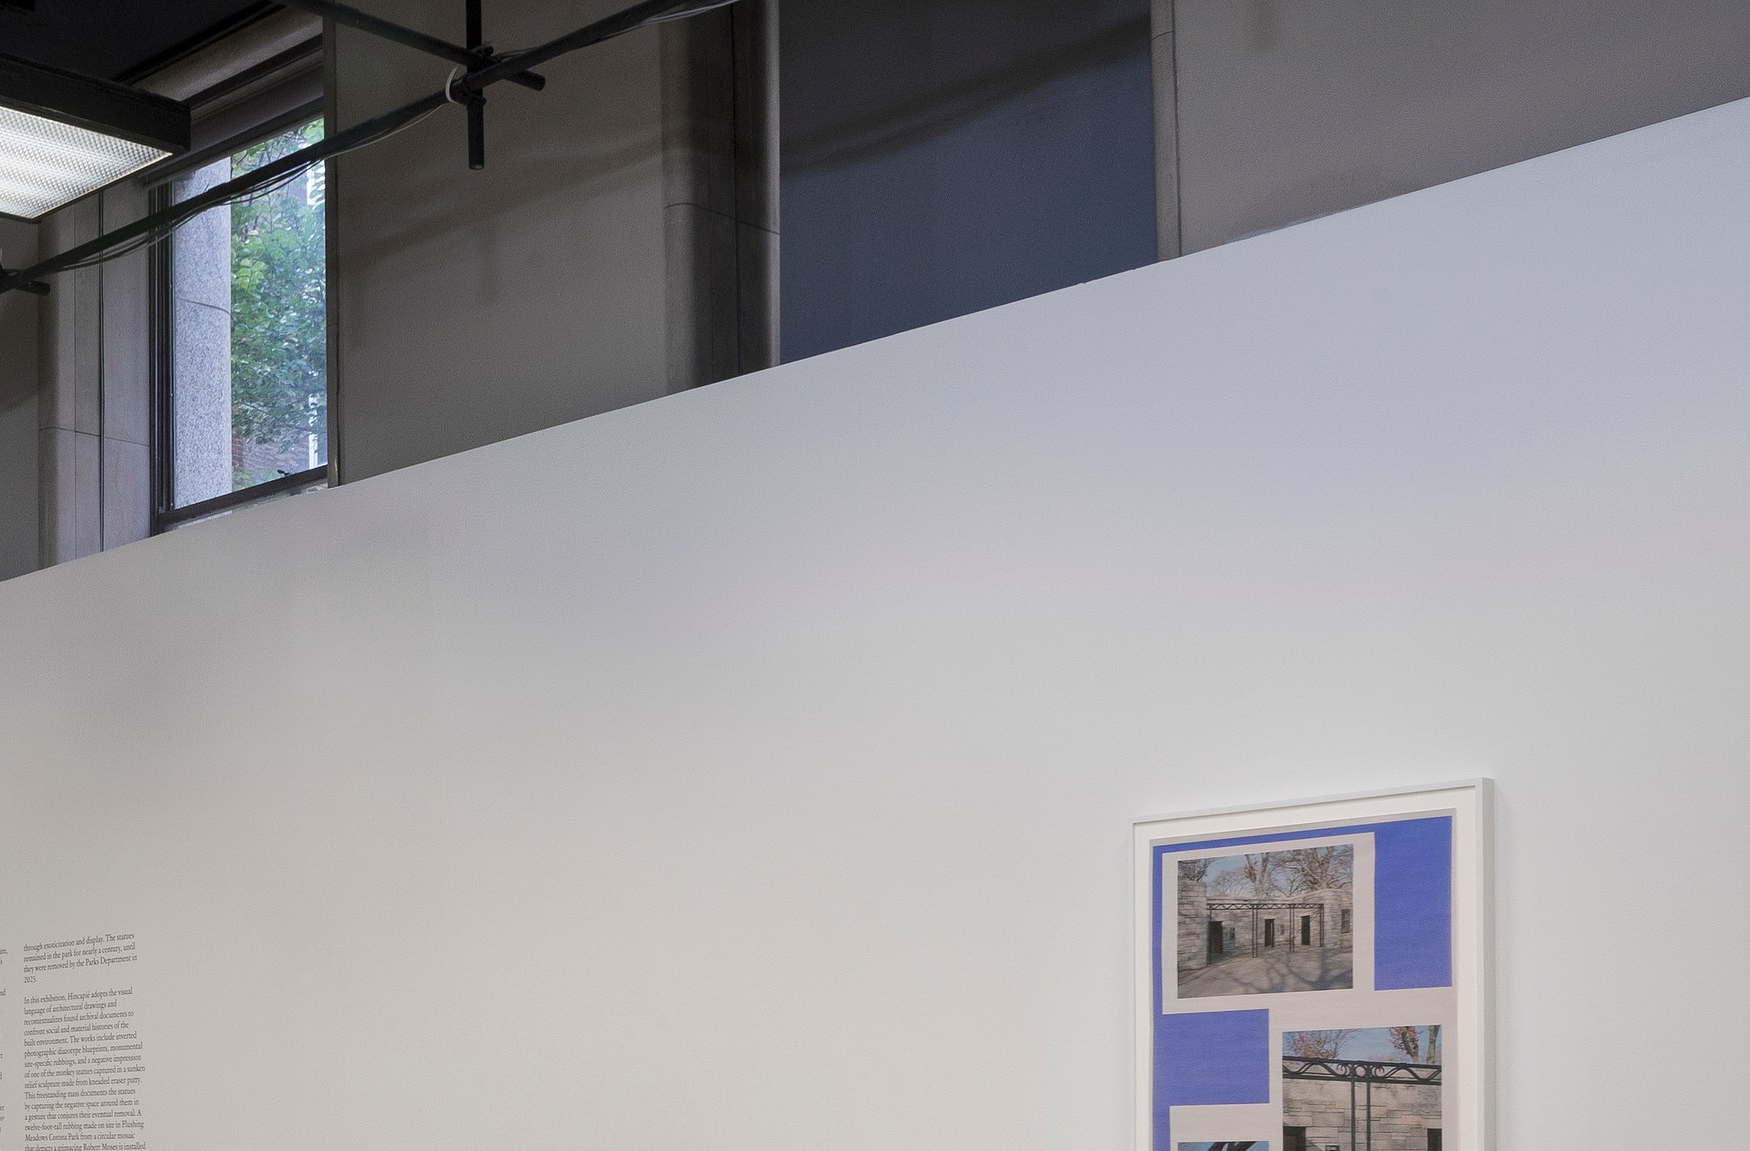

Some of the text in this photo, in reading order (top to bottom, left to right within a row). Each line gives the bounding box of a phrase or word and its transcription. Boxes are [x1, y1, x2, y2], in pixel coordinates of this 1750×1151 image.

[24, 942, 43, 952] through
[76, 937, 85, 946] and
[106, 934, 116, 942] The
[117, 933, 134, 941] statues
[24, 952, 46, 962] remained
[62, 949, 73, 960] park
[82, 947, 97, 957] nearly
[123, 943, 135, 952] until
[24, 964, 34, 974] they
[47, 960, 68, 970] removed
[76, 959, 84, 967] the
[85, 958, 99, 966] Parks
[100, 955, 131, 966] Department
[30, 995, 39, 1003] this
[91, 990, 108, 999] adopts
[109, 988, 117, 997] the
[118, 987, 133, 996] visual
[24, 1006, 45, 1016] language
[53, 1002, 83, 1012] architectural
[84, 1001, 106, 1010] drawings
[108, 999, 117, 1008] and
[24, 1027, 45, 1035] confront
[46, 1025, 60, 1034] social
[61, 1024, 70, 1033] and
[71, 1023, 91, 1032] material
[92, 1022, 113, 1030] histories
[120, 1020, 129, 1028] the
[24, 1038, 35, 1046] built
[70, 1035, 79, 1043] The
[81, 1034, 95, 1042] works
[97, 1032, 115, 1041] include
[116, 1031, 137, 1040] inverted
[24, 1047, 56, 1058] photographic
[110, 1041, 143, 1051] monumental
[56, 1067, 75, 1077] monkey
[76, 1067, 93, 1075] statues
[94, 1065, 116, 1076] captured
[127, 1064, 145, 1072] sunken
[31, 1101, 54, 1110] capturing
[55, 1100, 63, 1108] the
[64, 1100, 84, 1109] negative
[86, 1100, 99, 1108] space
[100, 1098, 118, 1106] around
[119, 1097, 133, 1105] them
[25, 1133, 48, 1141] Meadows
[48, 1132, 67, 1140] Corona
[68, 1132, 79, 1140] Park
[97, 1131, 116, 1139] circular
[58, 1143, 82, 1151] grimacing
[83, 1142, 100, 1150] Robert
[102, 1142, 118, 1150] Moses
[124, 1141, 146, 1149] installed
